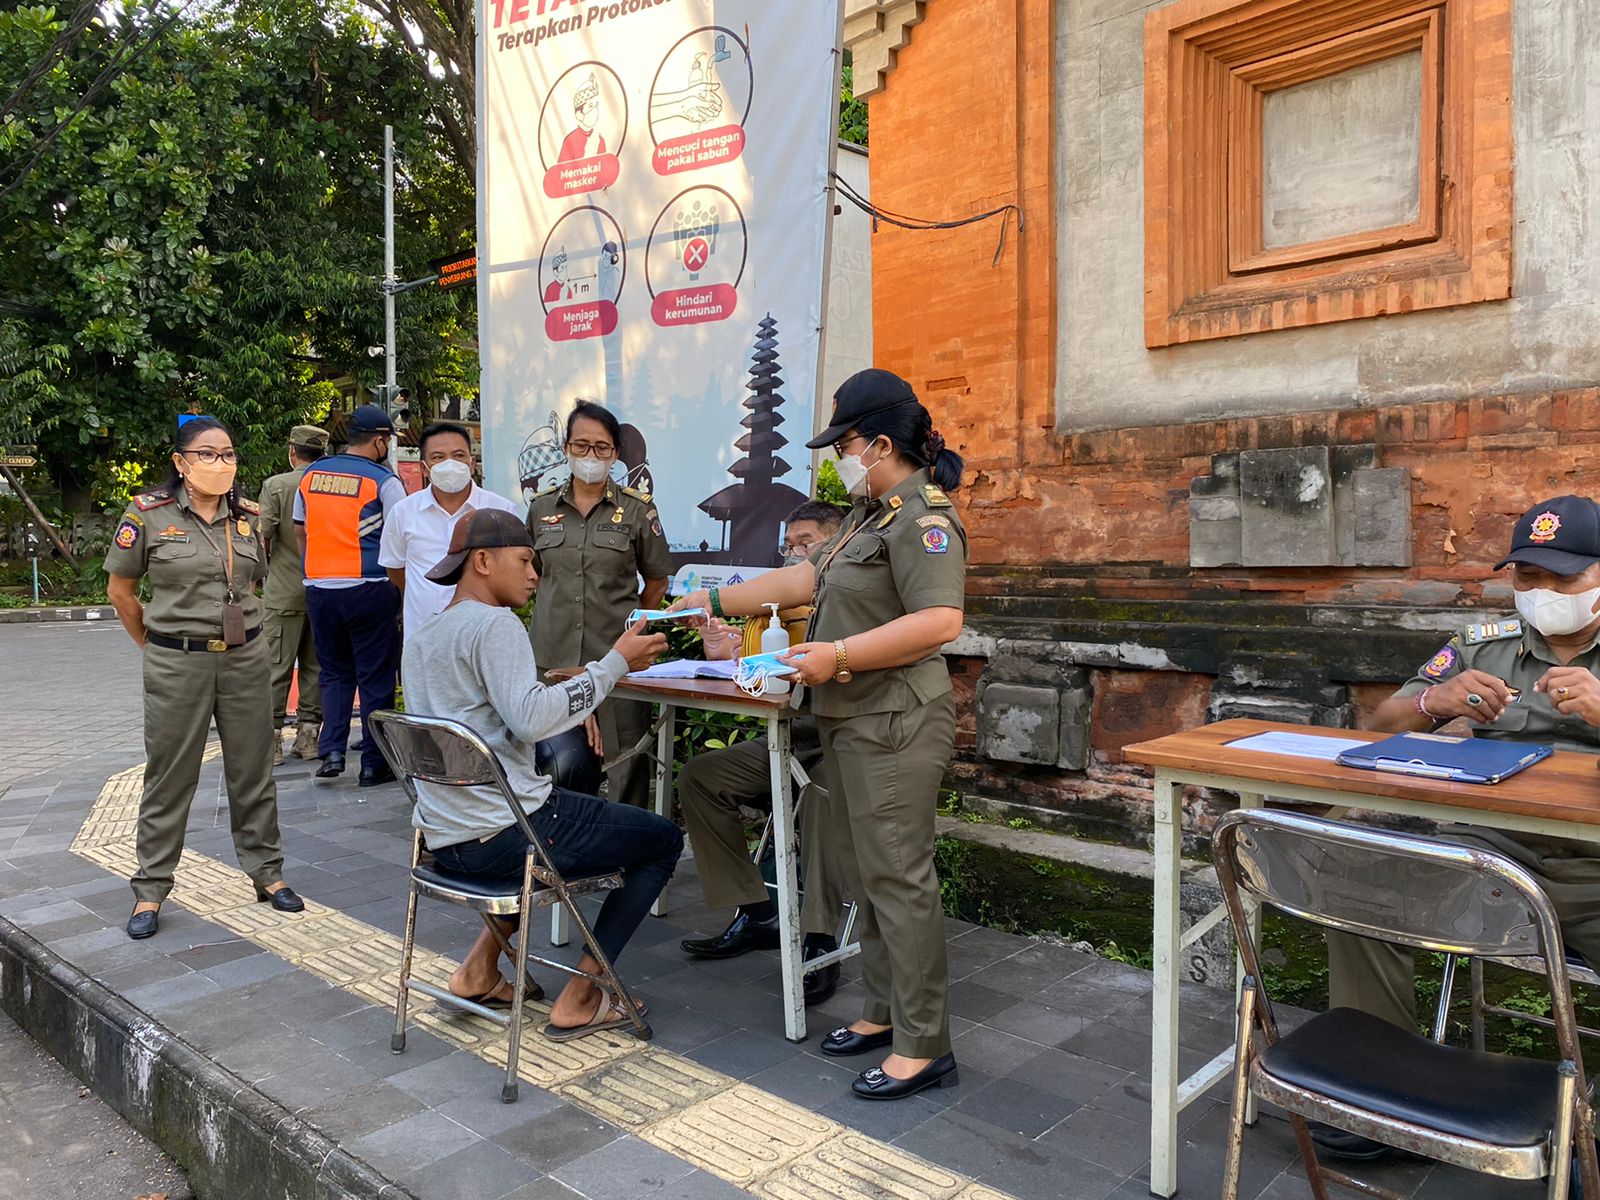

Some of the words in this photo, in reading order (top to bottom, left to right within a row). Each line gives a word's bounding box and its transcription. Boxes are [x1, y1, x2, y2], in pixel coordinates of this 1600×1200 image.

[497, 14, 583, 52] Terapkan
[658, 138, 700, 158] Mencuci
[702, 132, 740, 148] tangan
[667, 151, 695, 170] pakai
[697, 147, 729, 161] sabun
[560, 161, 602, 180] Memakai
[564, 175, 598, 190] masker
[573, 283, 578, 294] 1
[581, 284, 589, 292] m
[675, 291, 713, 307] Hindari
[563, 309, 600, 323] Menjaga
[665, 304, 723, 320] kerumunan
[569, 321, 593, 335] jarak
[310, 473, 359, 495] DISHUB
